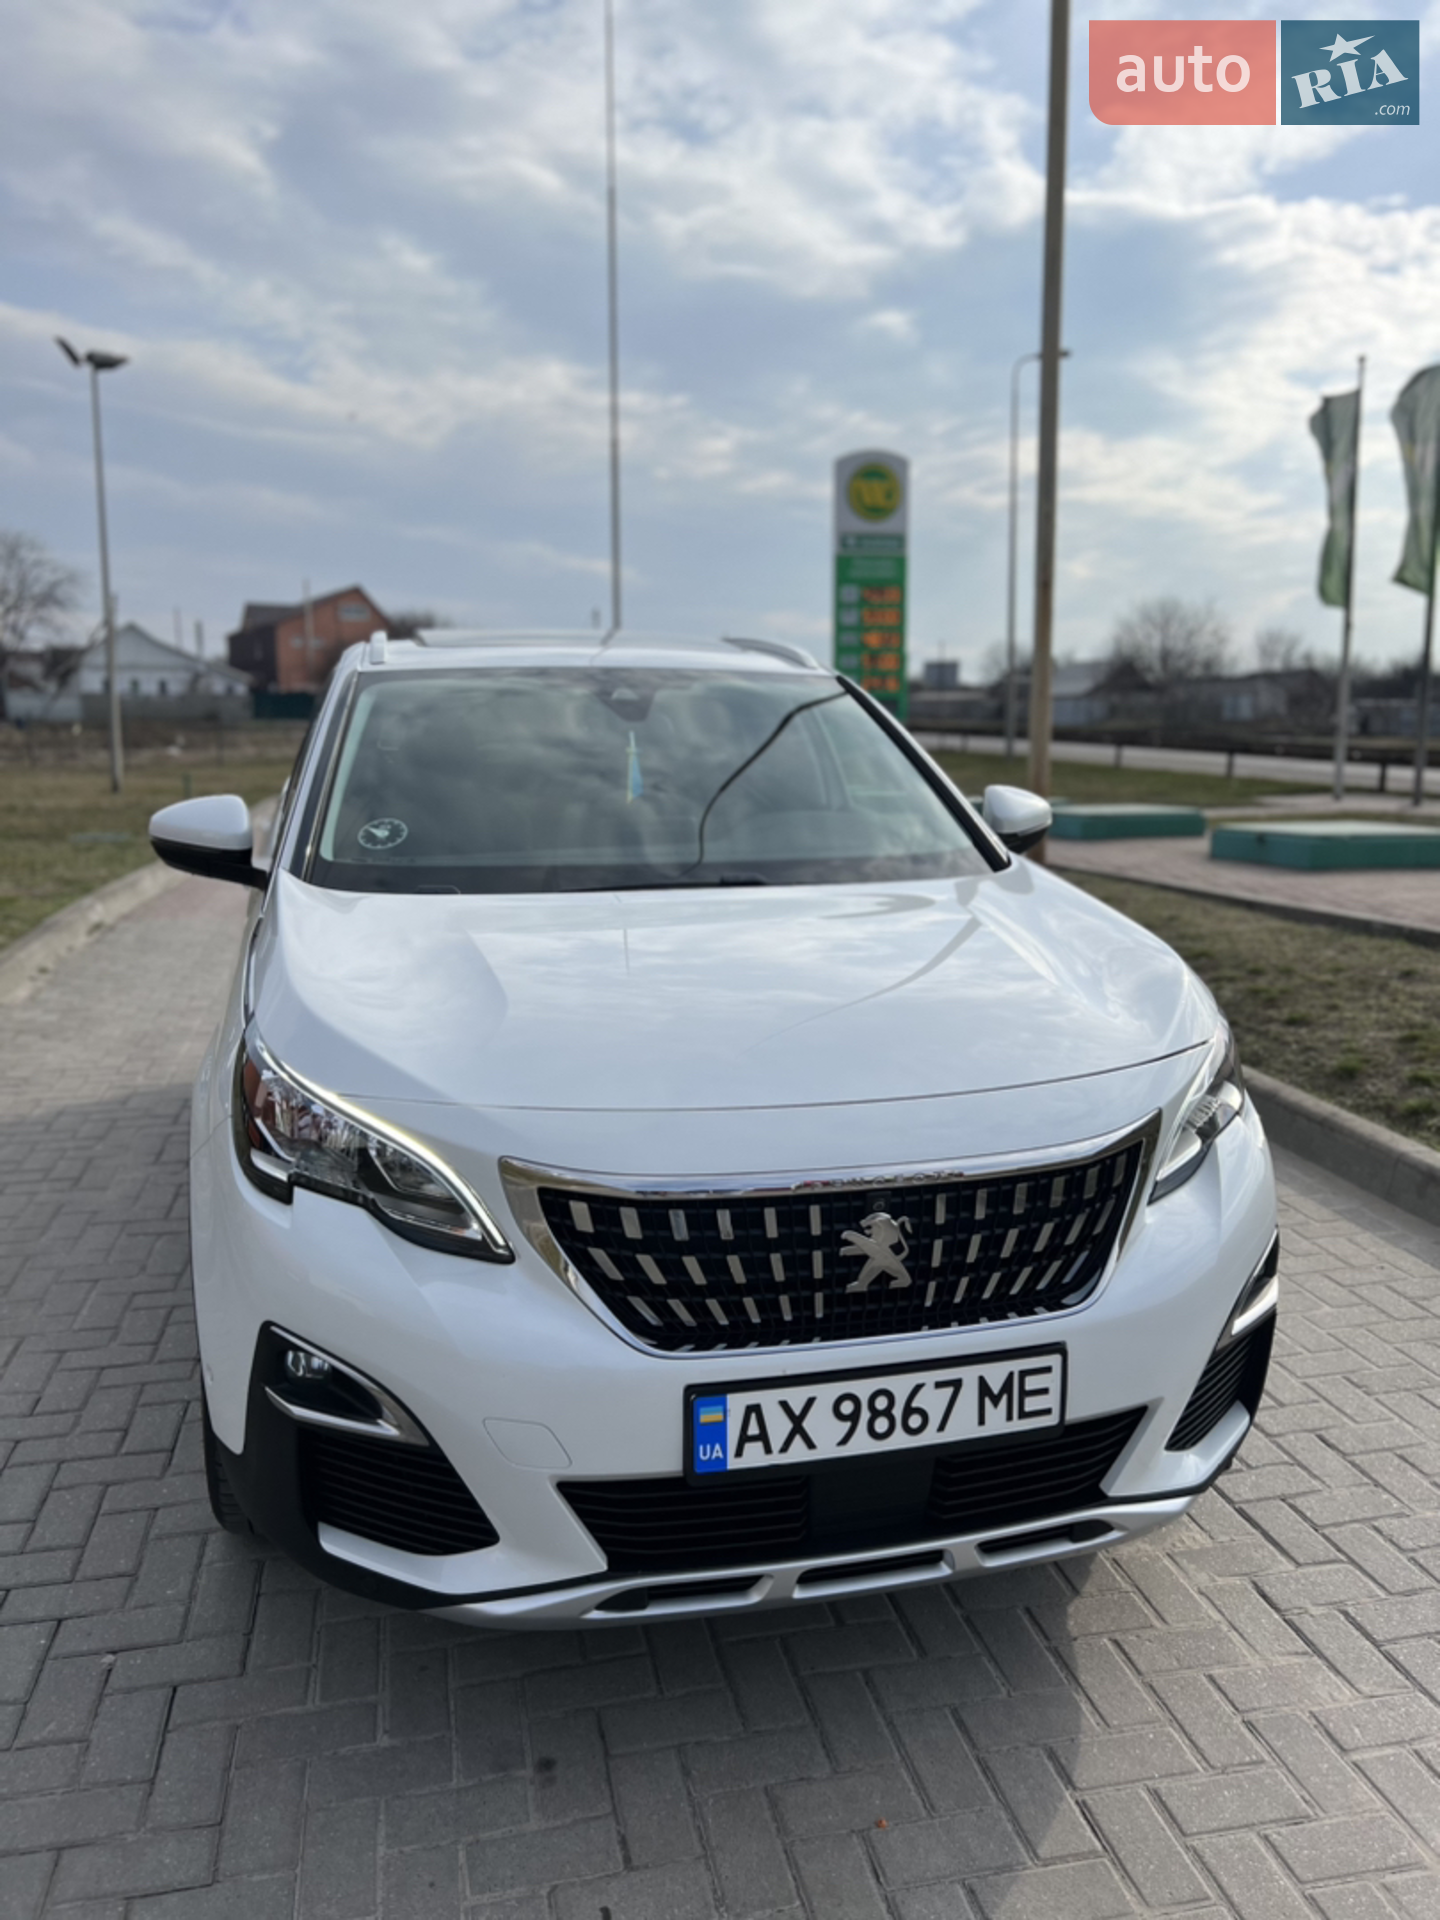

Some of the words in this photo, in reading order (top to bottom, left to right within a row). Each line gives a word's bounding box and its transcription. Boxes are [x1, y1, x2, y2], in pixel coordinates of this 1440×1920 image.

[733, 1396, 818, 1459] AX
[831, 1378, 963, 1447] 9867
[977, 1365, 1053, 1427] ME
[699, 1443, 723, 1460] UA
